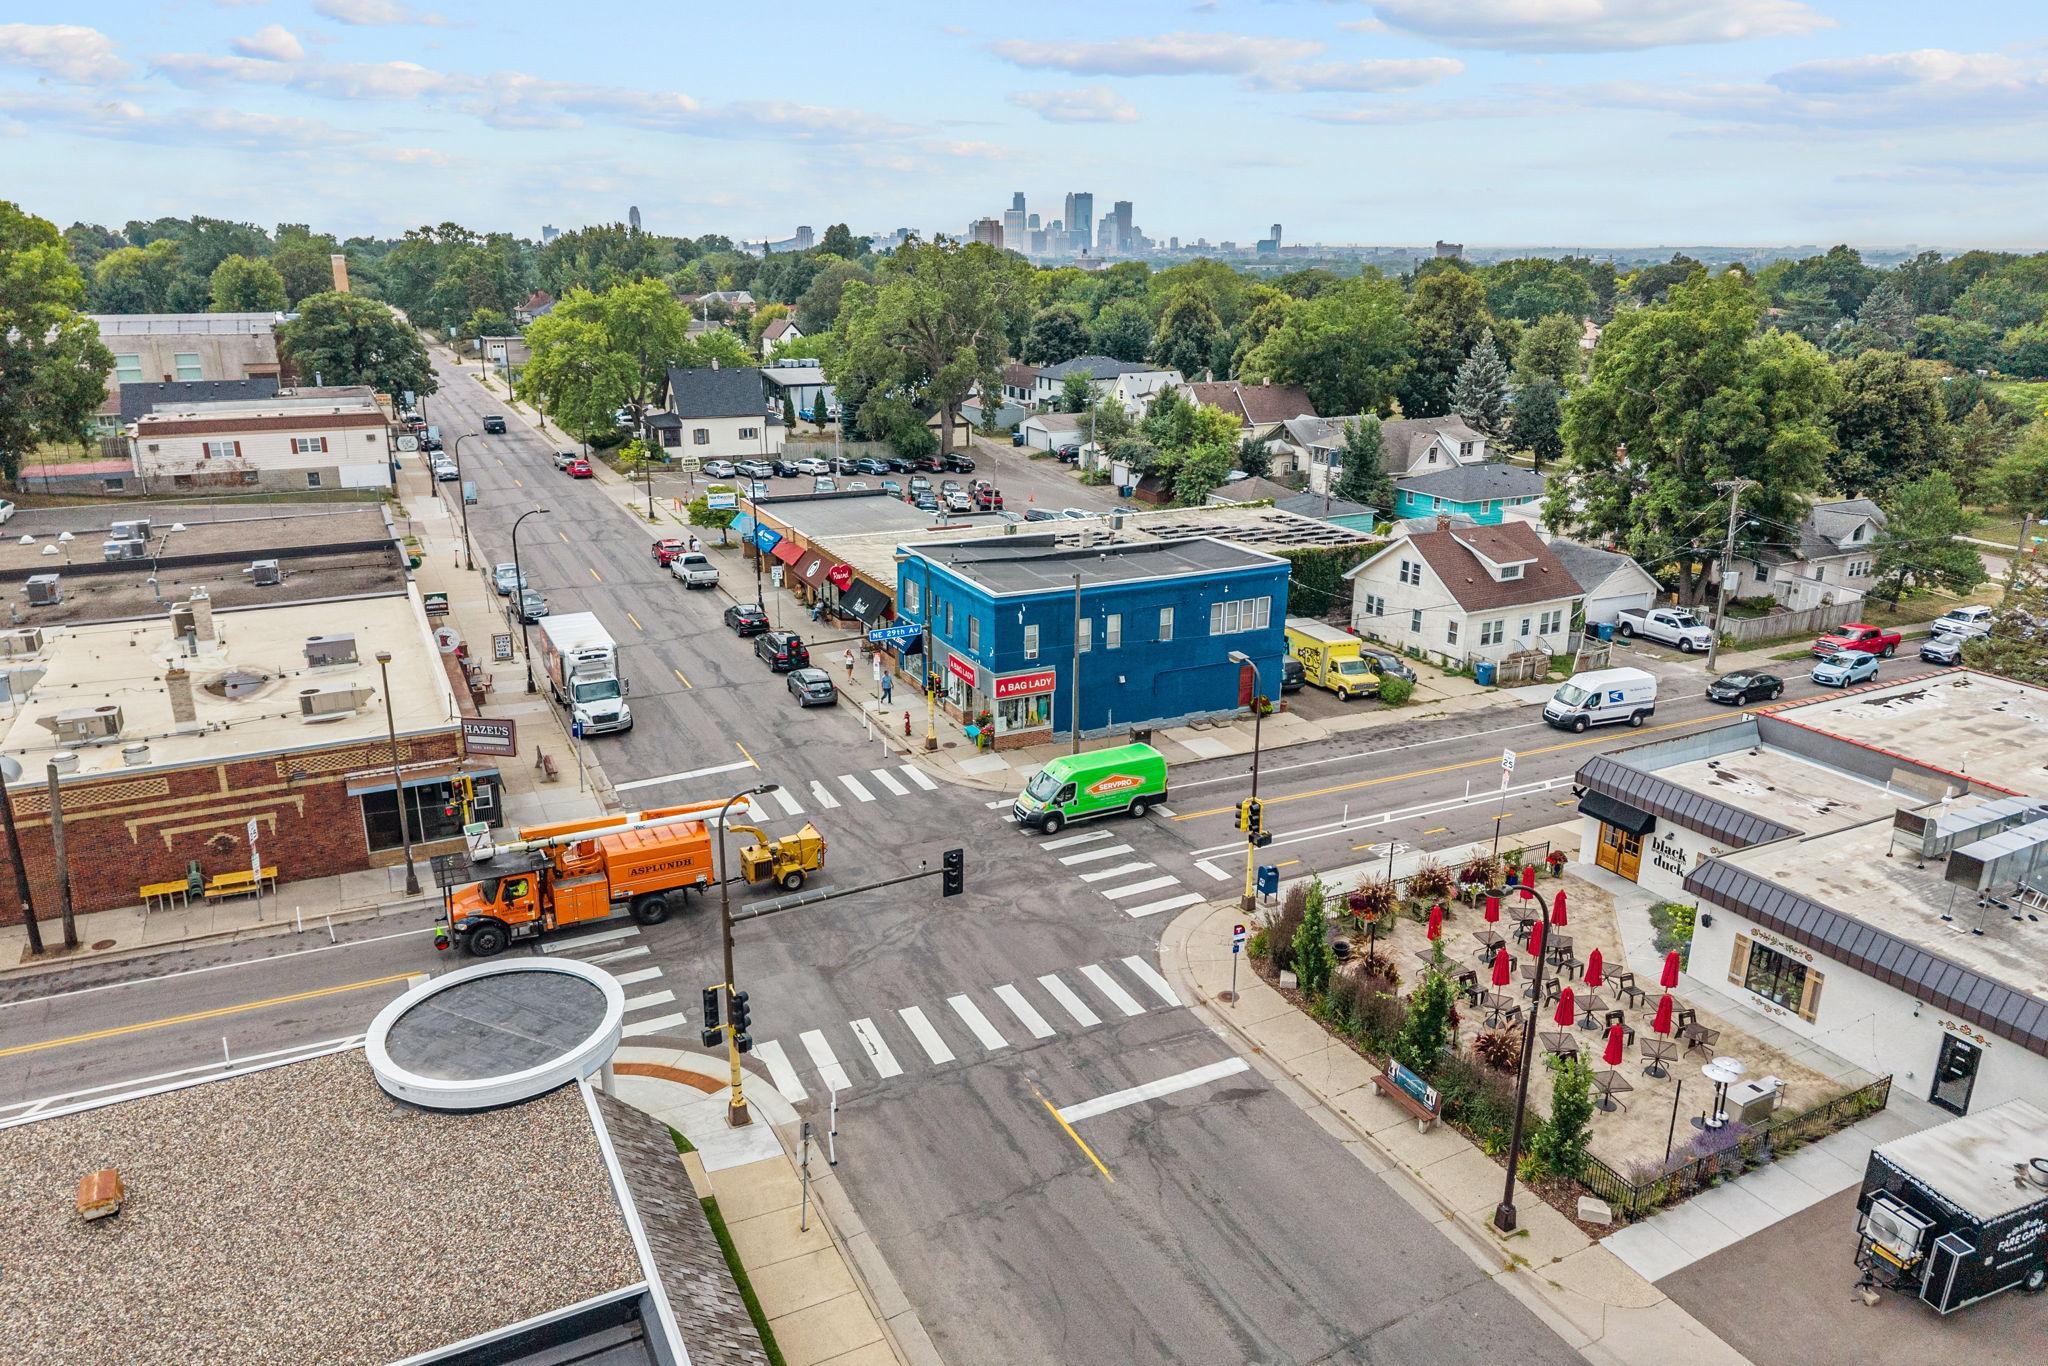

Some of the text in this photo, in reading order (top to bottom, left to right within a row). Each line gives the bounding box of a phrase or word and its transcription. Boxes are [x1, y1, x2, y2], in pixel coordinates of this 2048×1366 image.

[886, 629, 905, 637] 29th
[953, 663, 963, 674] BAG
[962, 668, 974, 680] LADY
[1008, 680, 1027, 691] BAG
[1029, 677, 1052, 689] LADY
[463, 724, 509, 736] HAZEL'S
[1503, 758, 1514, 769] 25
[1098, 778, 1133, 791] SERVPRO
[1652, 836, 1687, 862] black
[630, 858, 693, 877] ASPLUNDH
[1653, 854, 1685, 878] duck
[1997, 1234, 2021, 1251] FARE
[2022, 1223, 2048, 1241] GAME
